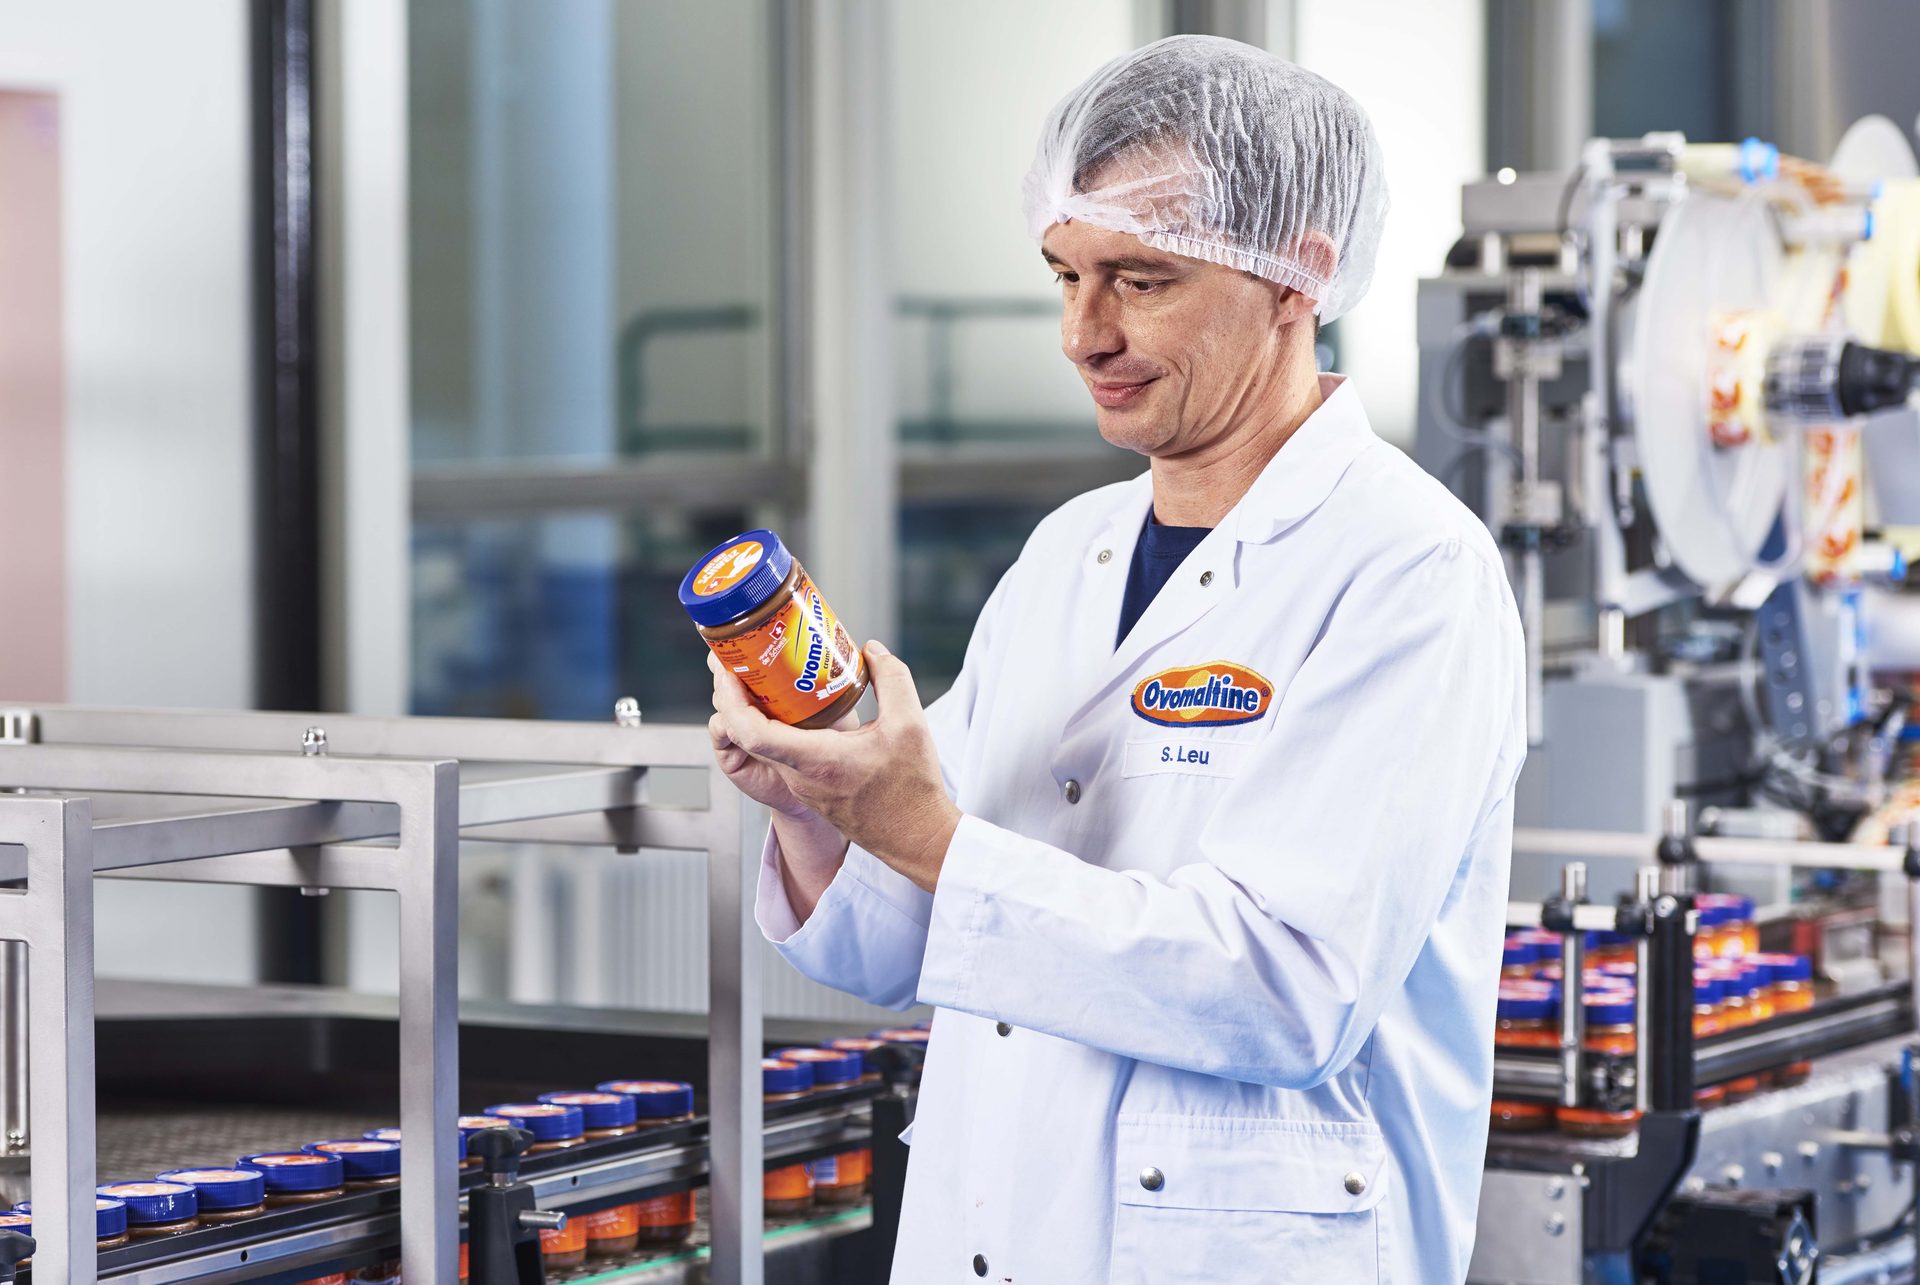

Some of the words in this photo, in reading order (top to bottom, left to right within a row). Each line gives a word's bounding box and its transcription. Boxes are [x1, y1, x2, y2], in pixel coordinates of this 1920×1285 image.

[1143, 676, 1258, 711] Ovomaltine
[1160, 745, 1173, 762] S.
[1176, 745, 1209, 764] Leu
